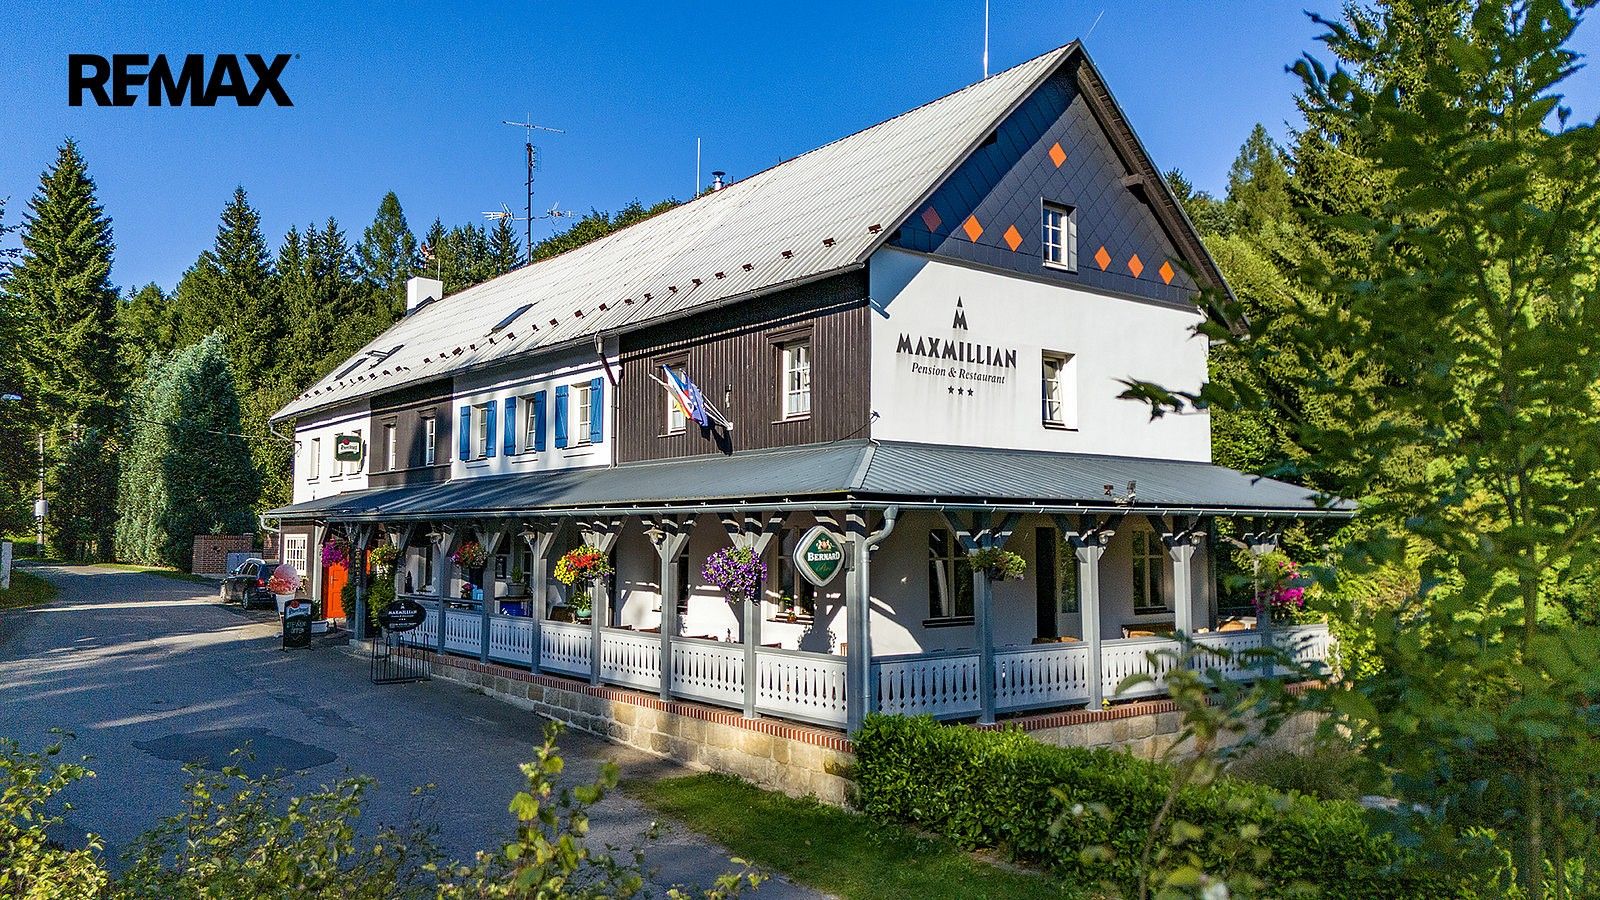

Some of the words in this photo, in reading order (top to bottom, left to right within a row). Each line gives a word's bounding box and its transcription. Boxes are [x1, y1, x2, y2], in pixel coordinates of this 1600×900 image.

[896, 332, 1016, 368] MAXMILLIAN
[912, 362, 946, 377] Pension
[948, 367, 957, 377] &
[959, 368, 1005, 384] Restaurant
